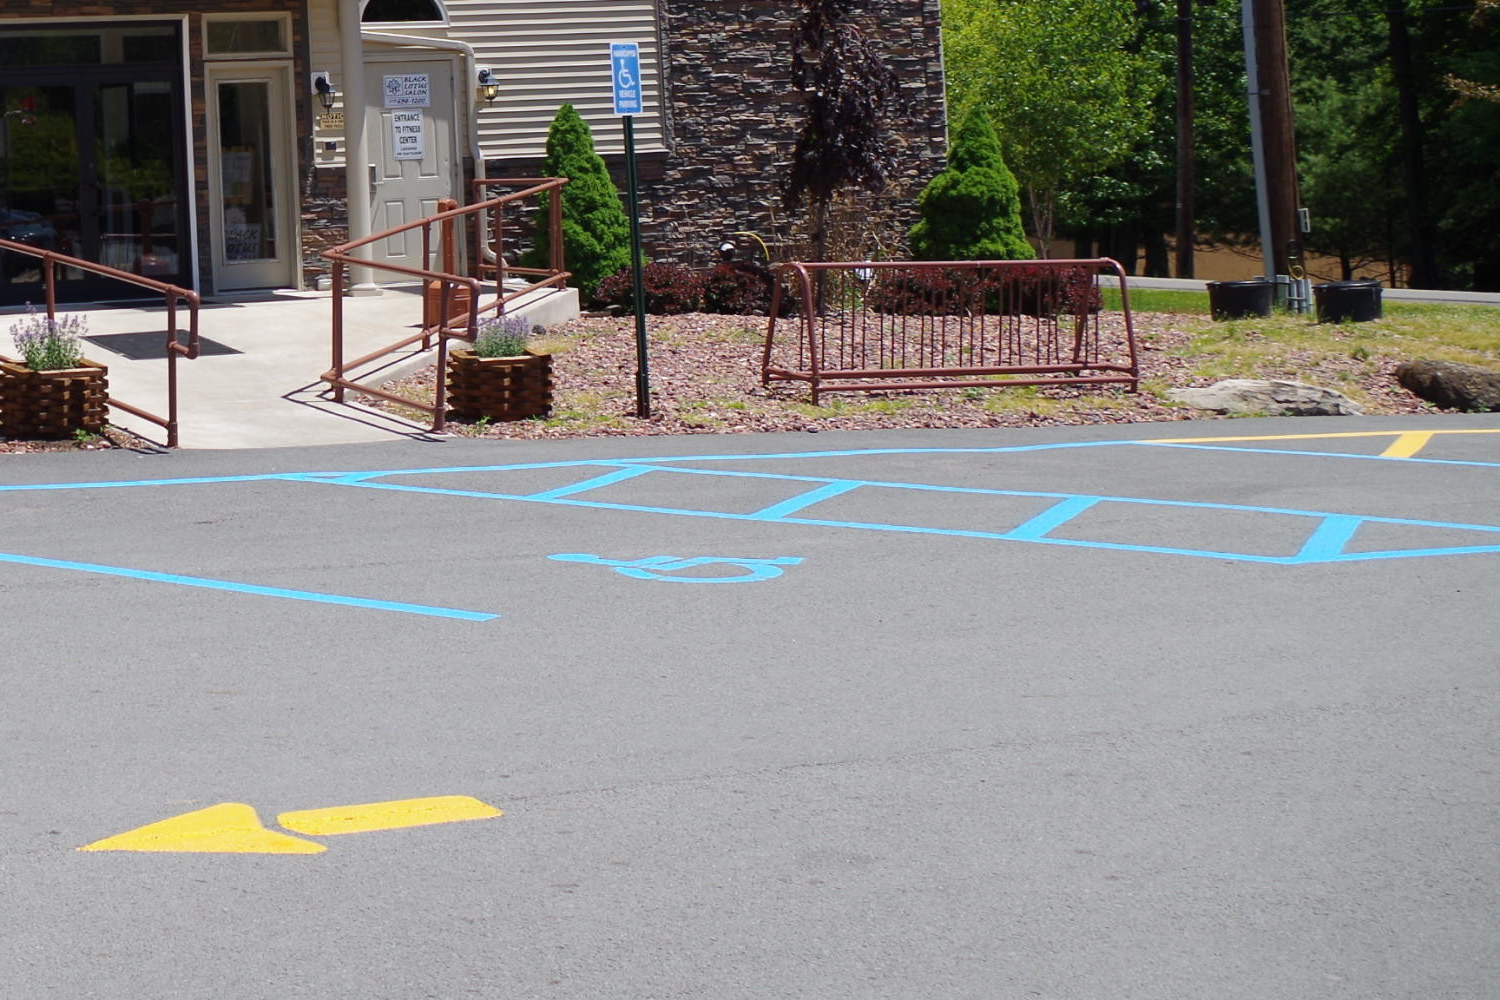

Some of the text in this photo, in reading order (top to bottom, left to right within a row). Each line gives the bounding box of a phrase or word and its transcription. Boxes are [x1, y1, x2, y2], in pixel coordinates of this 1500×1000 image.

[394, 113, 420, 122] ENTRANCE
[402, 125, 421, 133] FITNESS
[399, 136, 417, 144] CENTER
